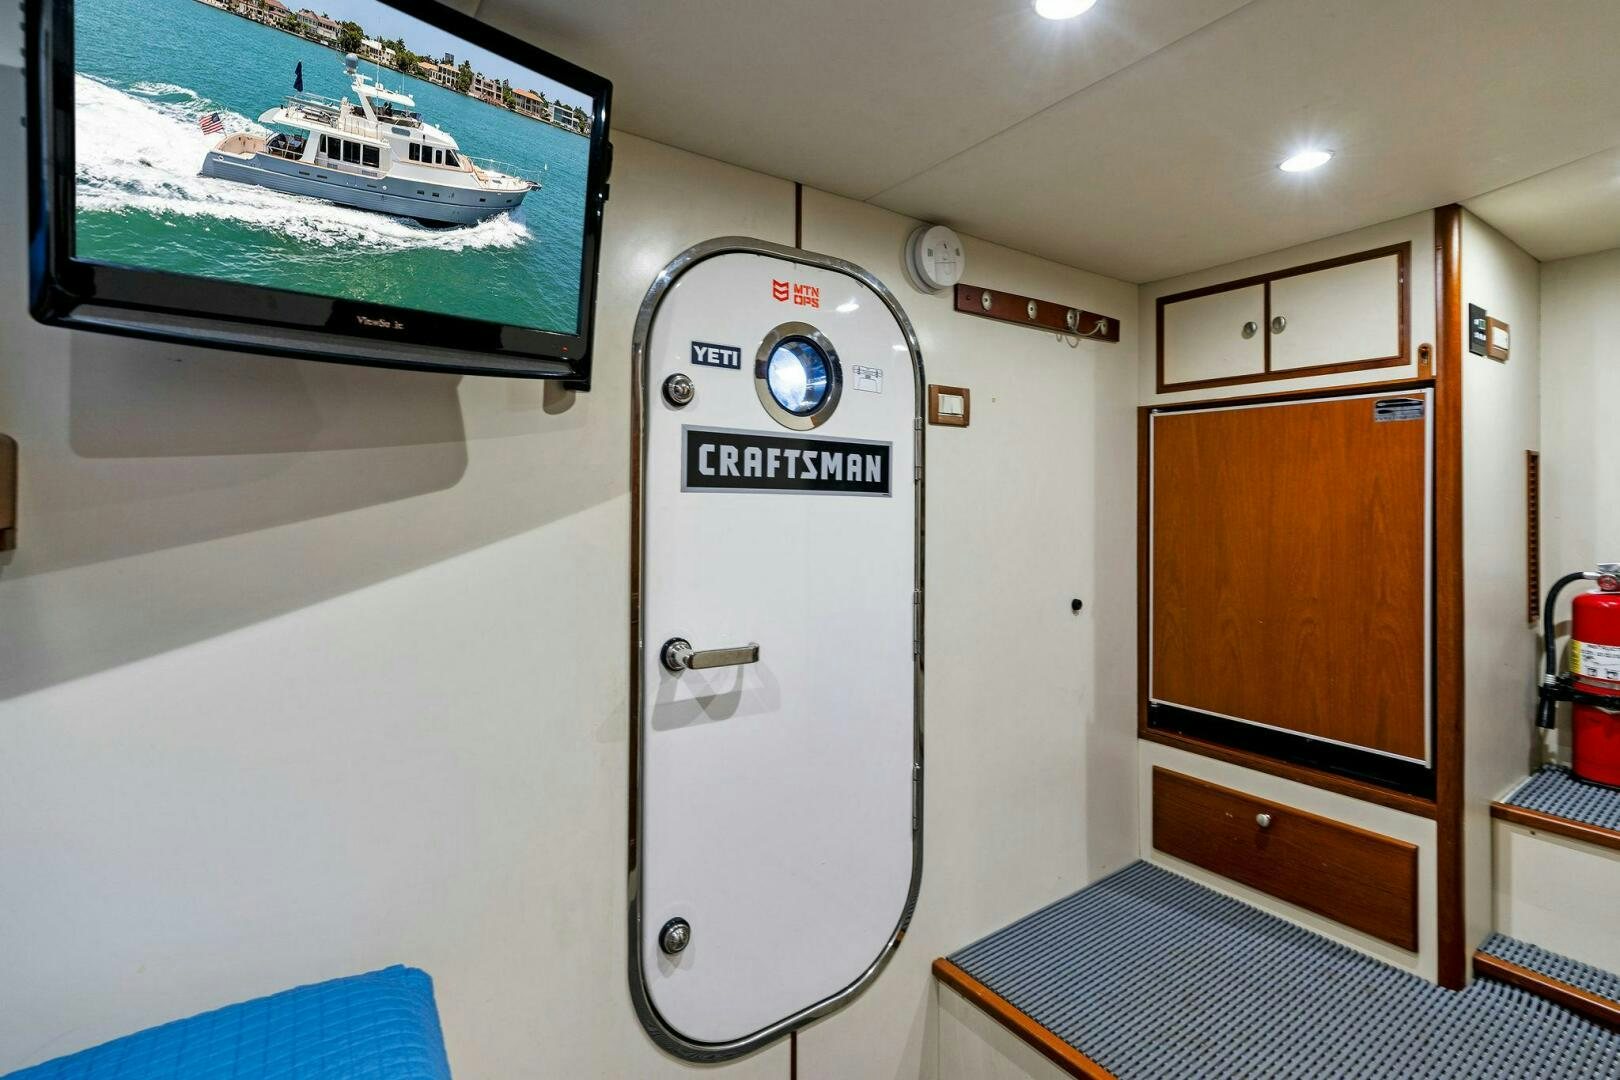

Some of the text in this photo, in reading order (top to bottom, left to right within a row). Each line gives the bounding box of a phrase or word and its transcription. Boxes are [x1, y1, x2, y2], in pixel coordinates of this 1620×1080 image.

[793, 284, 819, 298] MTN
[793, 294, 819, 308] OPS
[356, 315, 404, 330] ViewSoic
[693, 345, 738, 366] YETI
[698, 444, 881, 482] CRAFTSMAN
